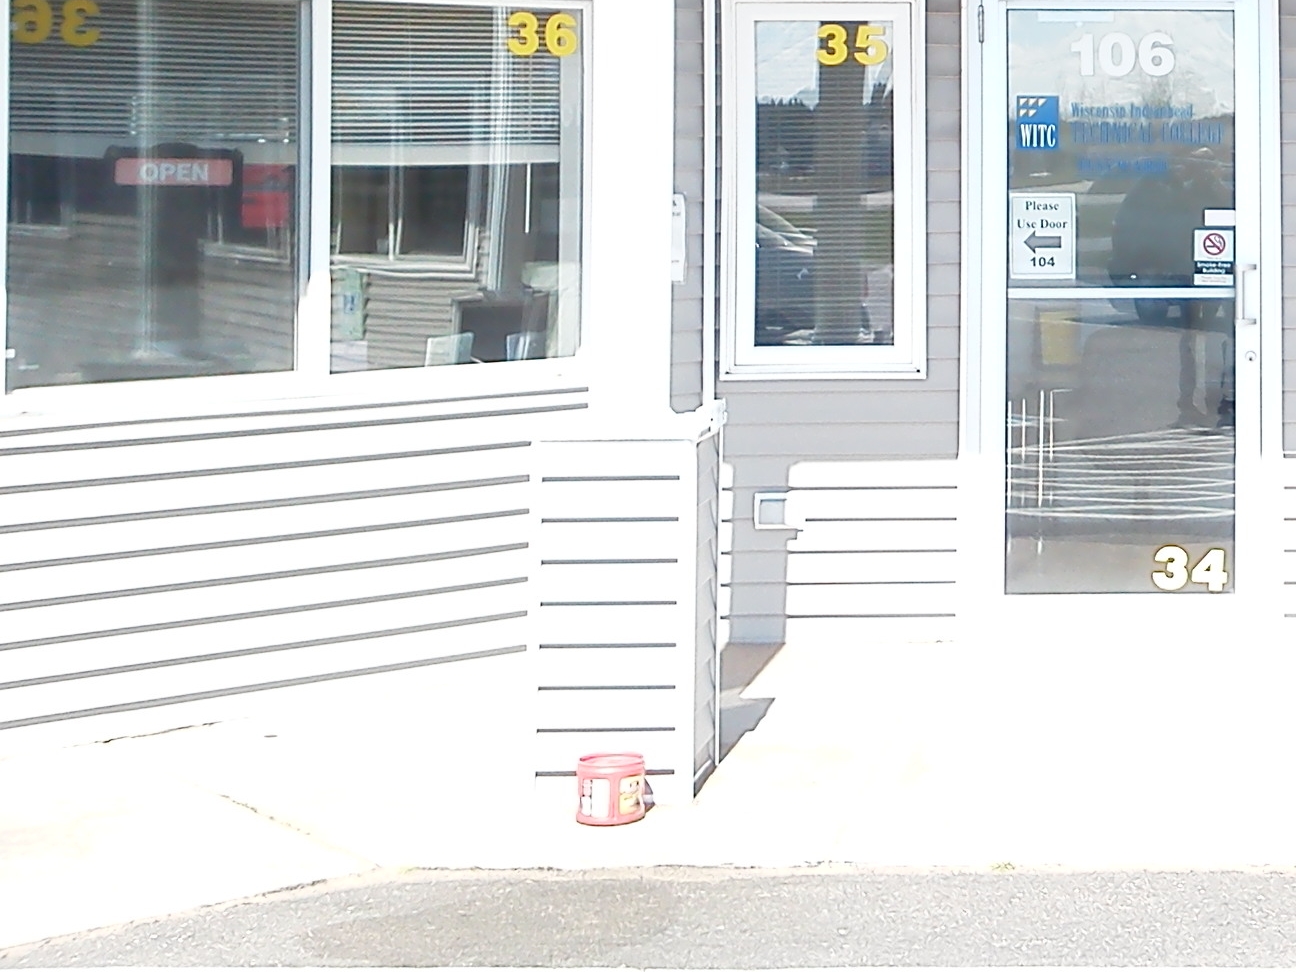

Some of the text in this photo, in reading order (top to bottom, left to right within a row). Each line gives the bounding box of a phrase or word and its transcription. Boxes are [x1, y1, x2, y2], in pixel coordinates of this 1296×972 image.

[507, 12, 577, 56] 36
[816, 24, 889, 66] 35
[1070, 32, 1176, 77] 106
[1071, 102, 1126, 118] Wisconsin
[1020, 124, 1056, 148] WITC
[138, 162, 210, 183] OPEN
[1025, 200, 1059, 211] Please
[1017, 219, 1068, 229] Use Door
[1030, 256, 1056, 267] 104
[1151, 545, 1228, 593] 34
